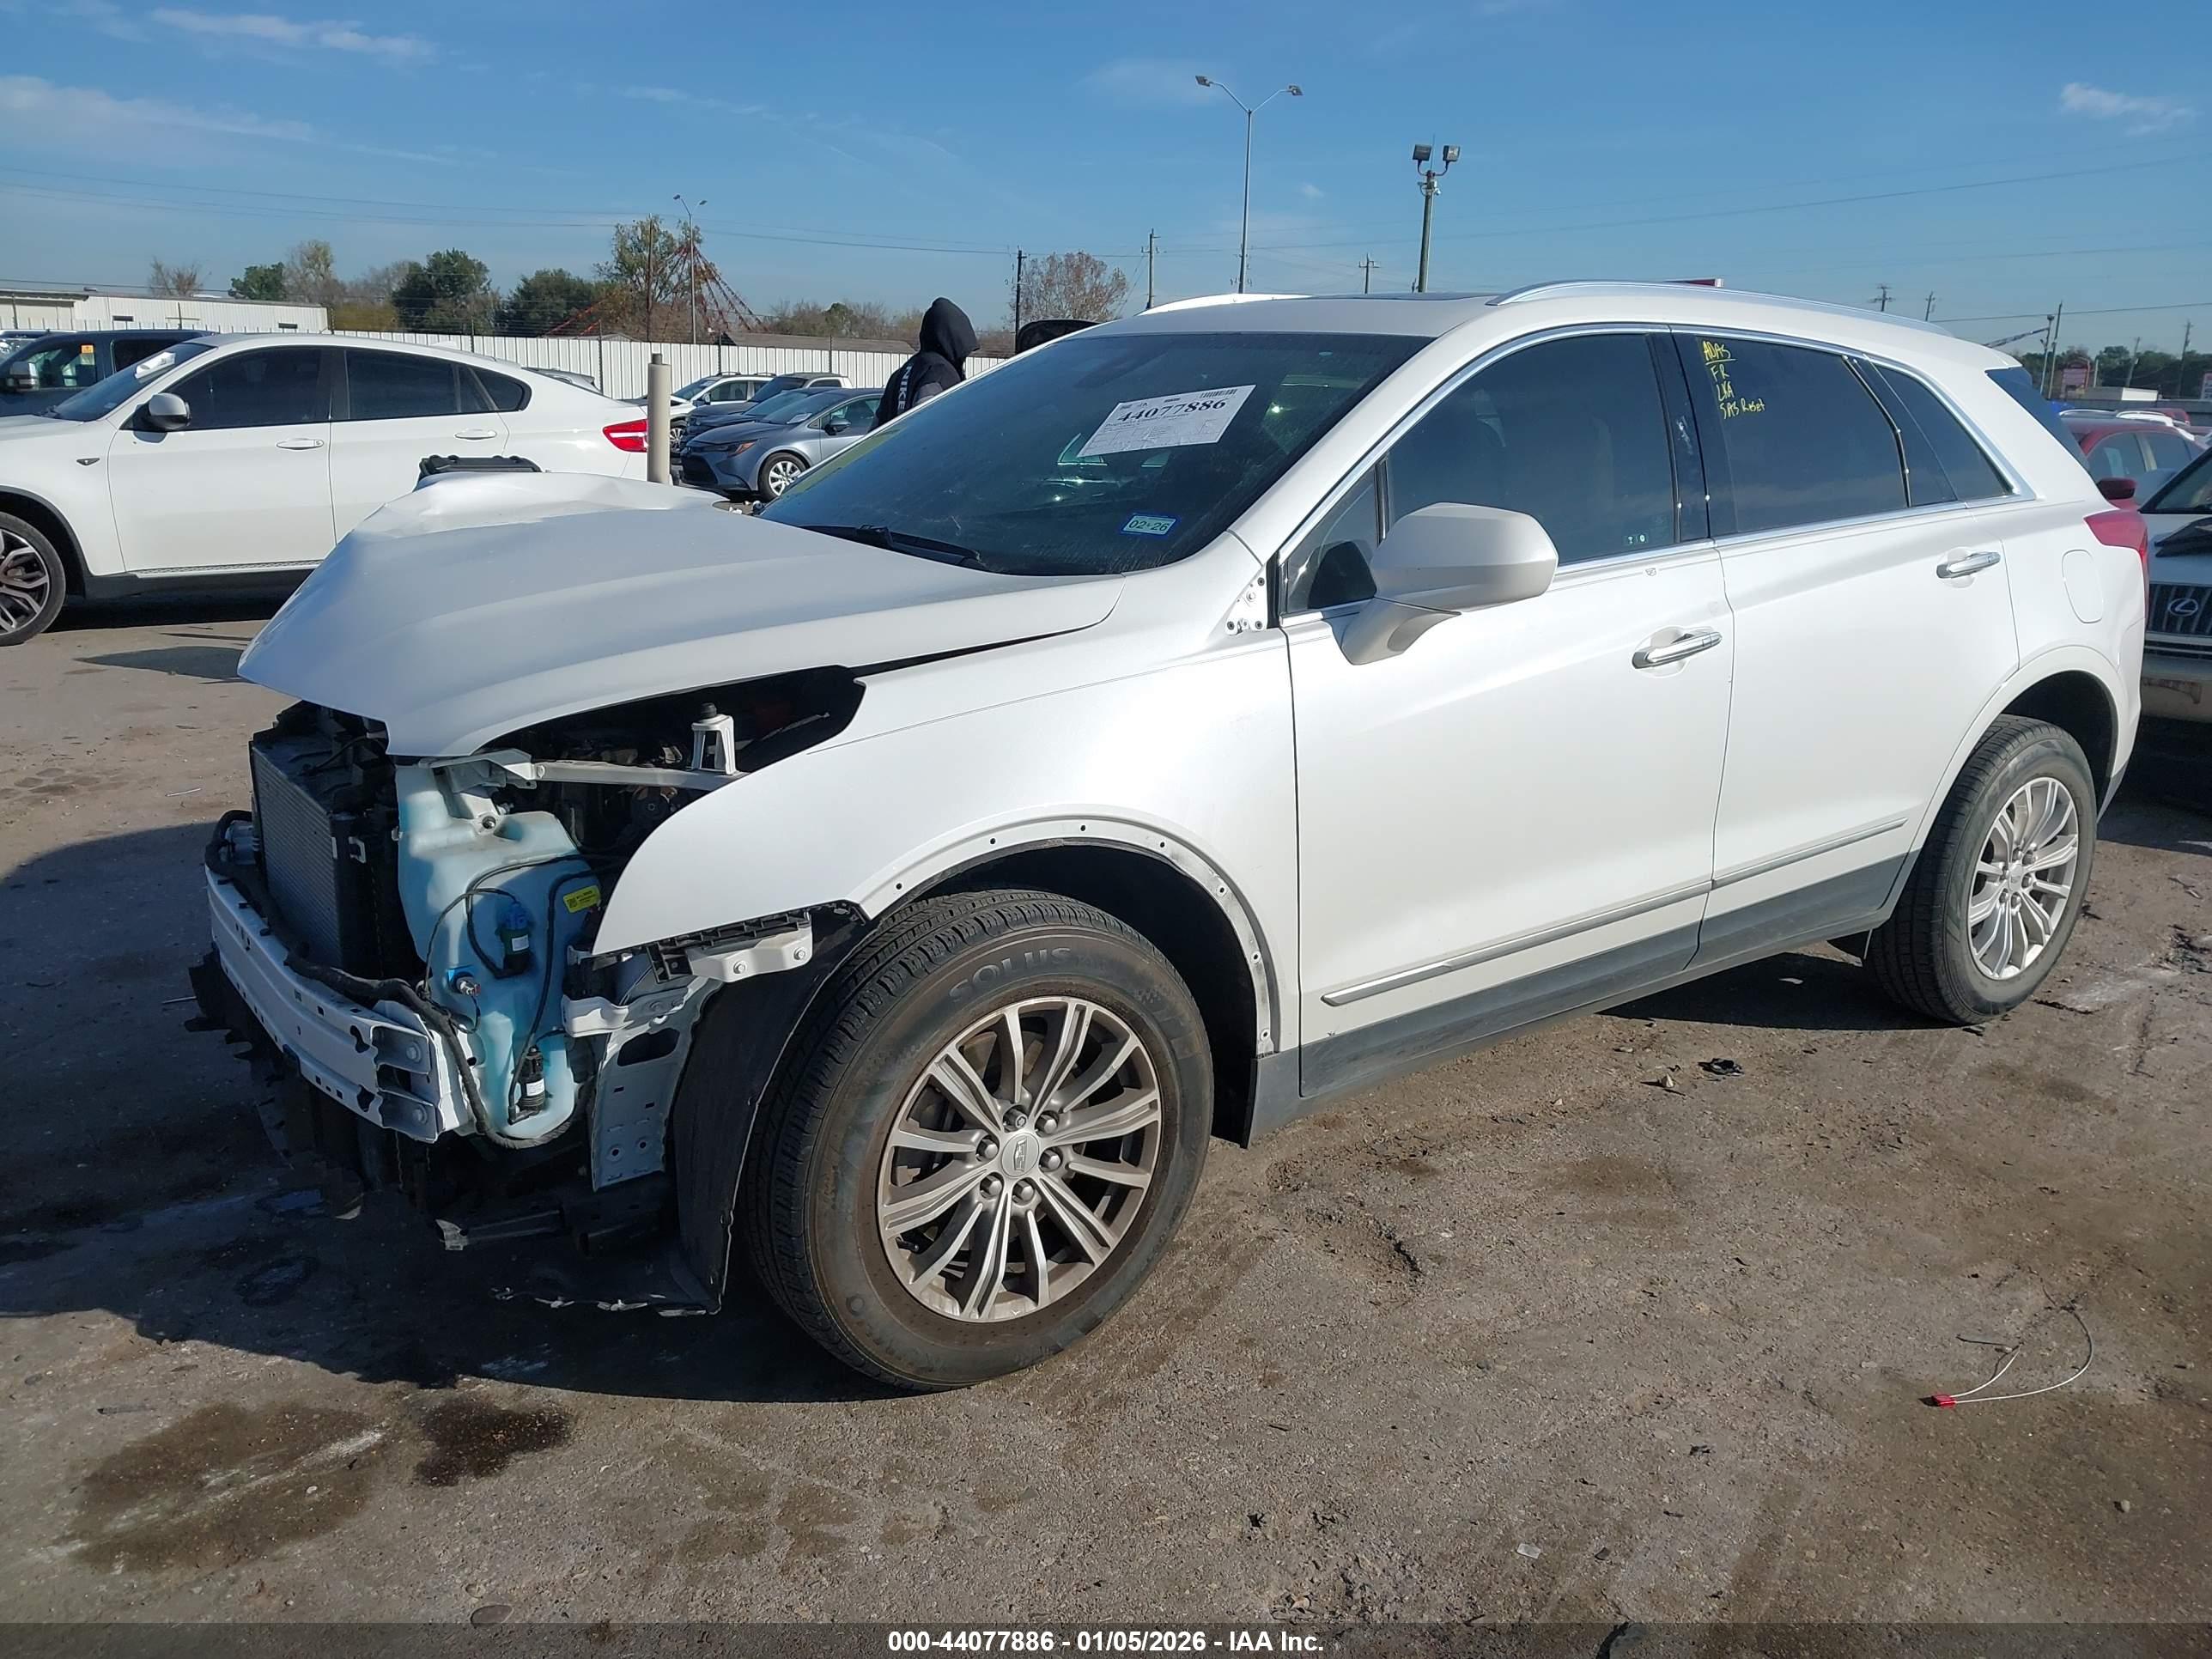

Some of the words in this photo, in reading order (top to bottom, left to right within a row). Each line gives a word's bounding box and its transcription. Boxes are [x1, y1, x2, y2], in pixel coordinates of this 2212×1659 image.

[897, 366, 913, 410] NIKE
[1117, 398, 1228, 422] 44077886
[949, 947, 1072, 1001] SOLUS
